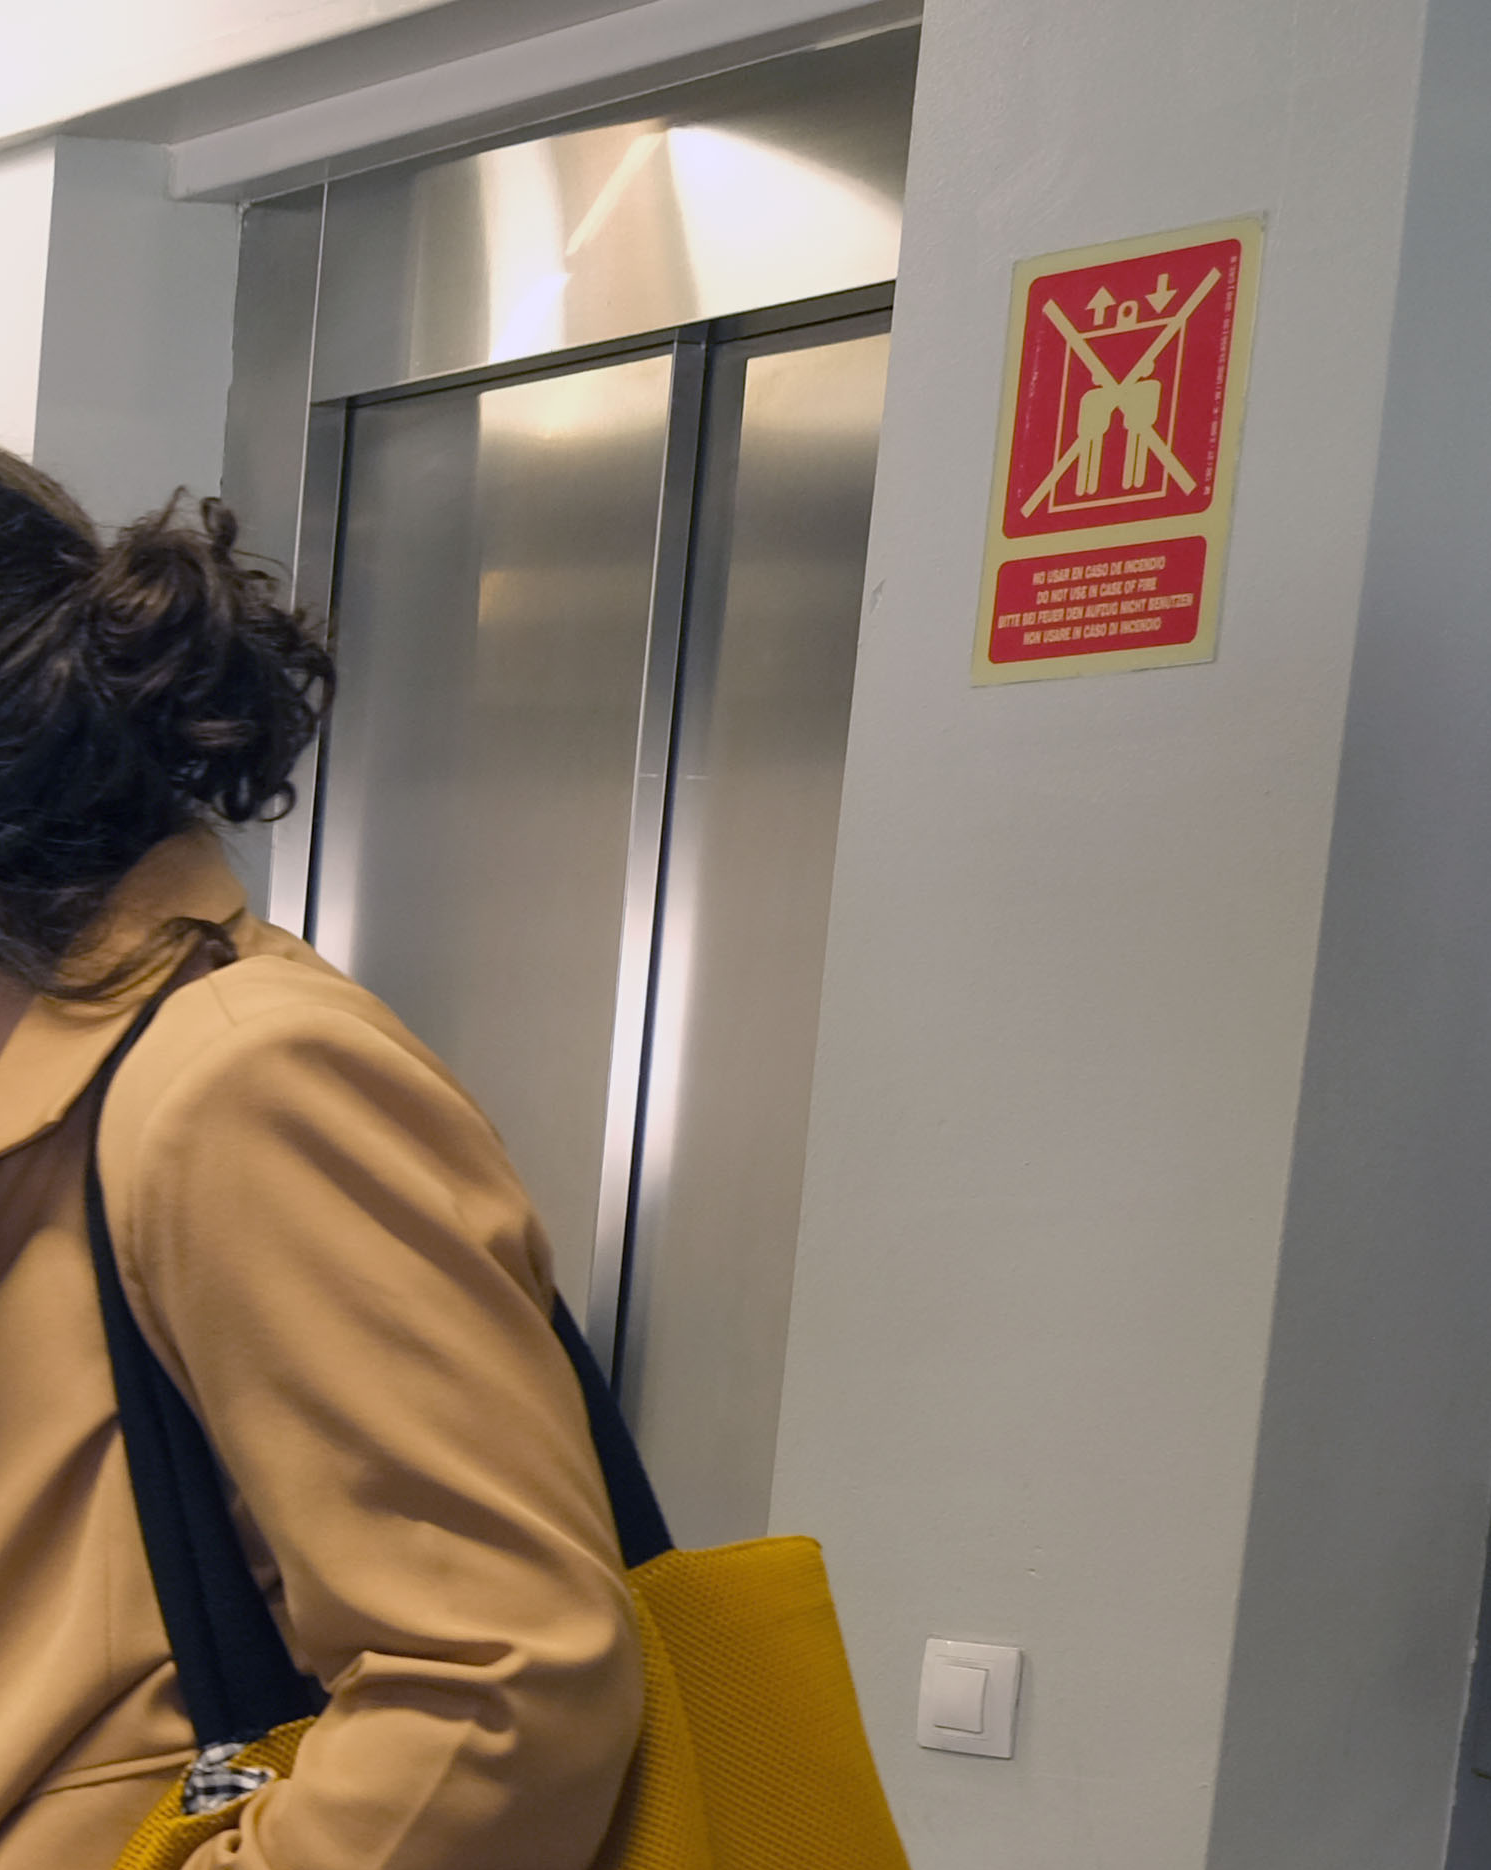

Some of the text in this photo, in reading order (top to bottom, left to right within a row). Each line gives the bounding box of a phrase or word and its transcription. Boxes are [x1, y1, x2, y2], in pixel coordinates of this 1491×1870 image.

[1032, 556, 1166, 586] NO USAR EN CASO DE INCENDIO
[1036, 577, 1158, 605] DO NOT USE IN CASE OF FIRE
[998, 593, 1194, 629] BITTE BEI FEUER DEN AUFZUG NICHT BENUTZEN
[1023, 616, 1162, 645] NON USARE IN CASO DI INCENDIO
